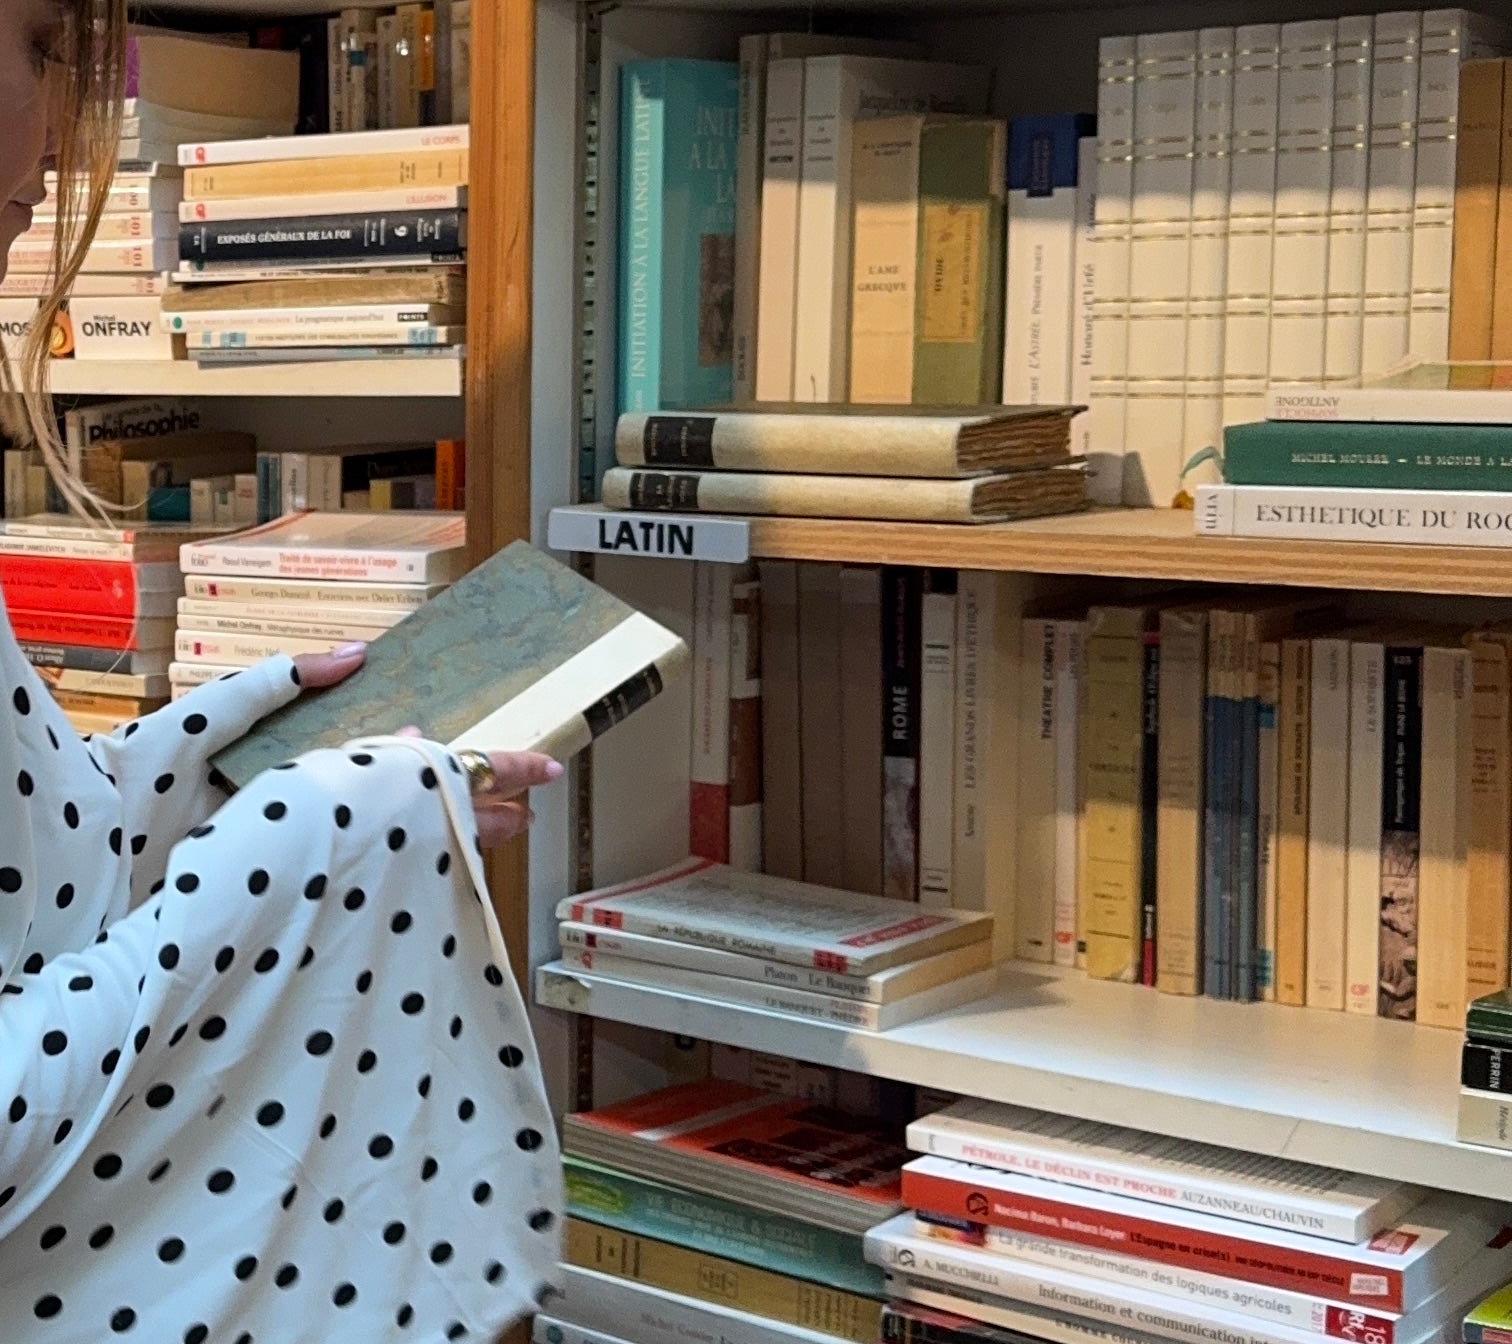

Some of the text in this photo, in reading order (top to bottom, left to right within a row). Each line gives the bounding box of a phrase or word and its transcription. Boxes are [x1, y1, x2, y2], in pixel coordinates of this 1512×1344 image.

[217, 230, 351, 245] EXPOSÉS GÉNÉRAUX DE LA FOI
[82, 321, 151, 338] ONFRAY
[1257, 504, 1410, 528] ESTHETIQUE
[1422, 510, 1456, 528] DU
[598, 519, 694, 555] LATIN
[891, 685, 908, 740] ROME
[1038, 1283, 1115, 1313] Information
[1120, 1304, 1132, 1318] et
